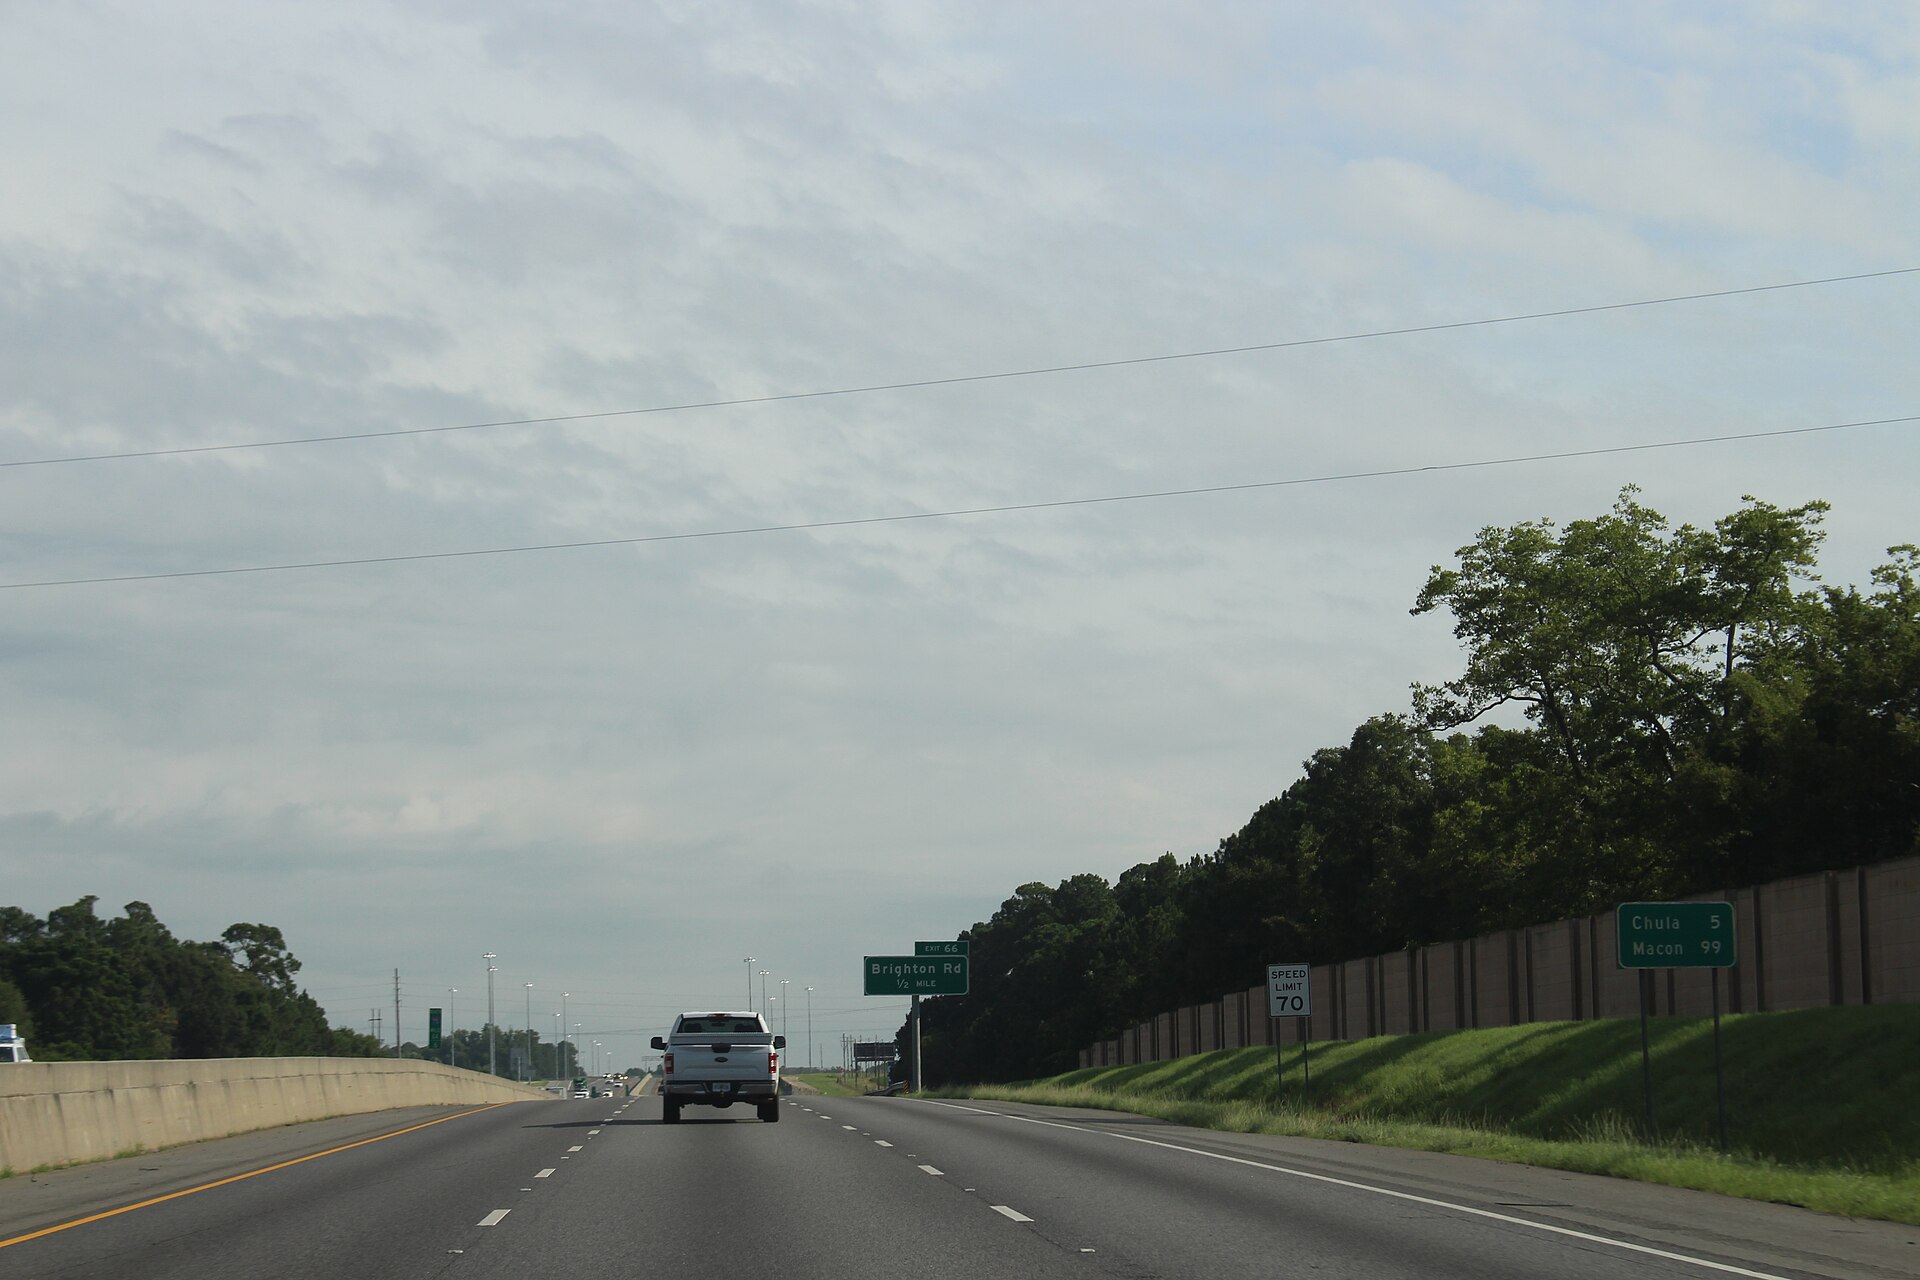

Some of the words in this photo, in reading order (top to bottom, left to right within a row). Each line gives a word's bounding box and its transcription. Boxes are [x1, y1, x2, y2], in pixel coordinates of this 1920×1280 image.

[1632, 915, 1680, 930] Chula
[1710, 915, 1720, 929] 5
[944, 944, 958, 953] 66
[1633, 941, 1684, 956] Macon
[1701, 940, 1721, 954] 99
[872, 963, 936, 977] Brighton
[943, 963, 961, 974] Rd
[1271, 969, 1306, 979] SPEED
[1275, 982, 1303, 991] LIMIT
[1275, 995, 1304, 1011] 70
